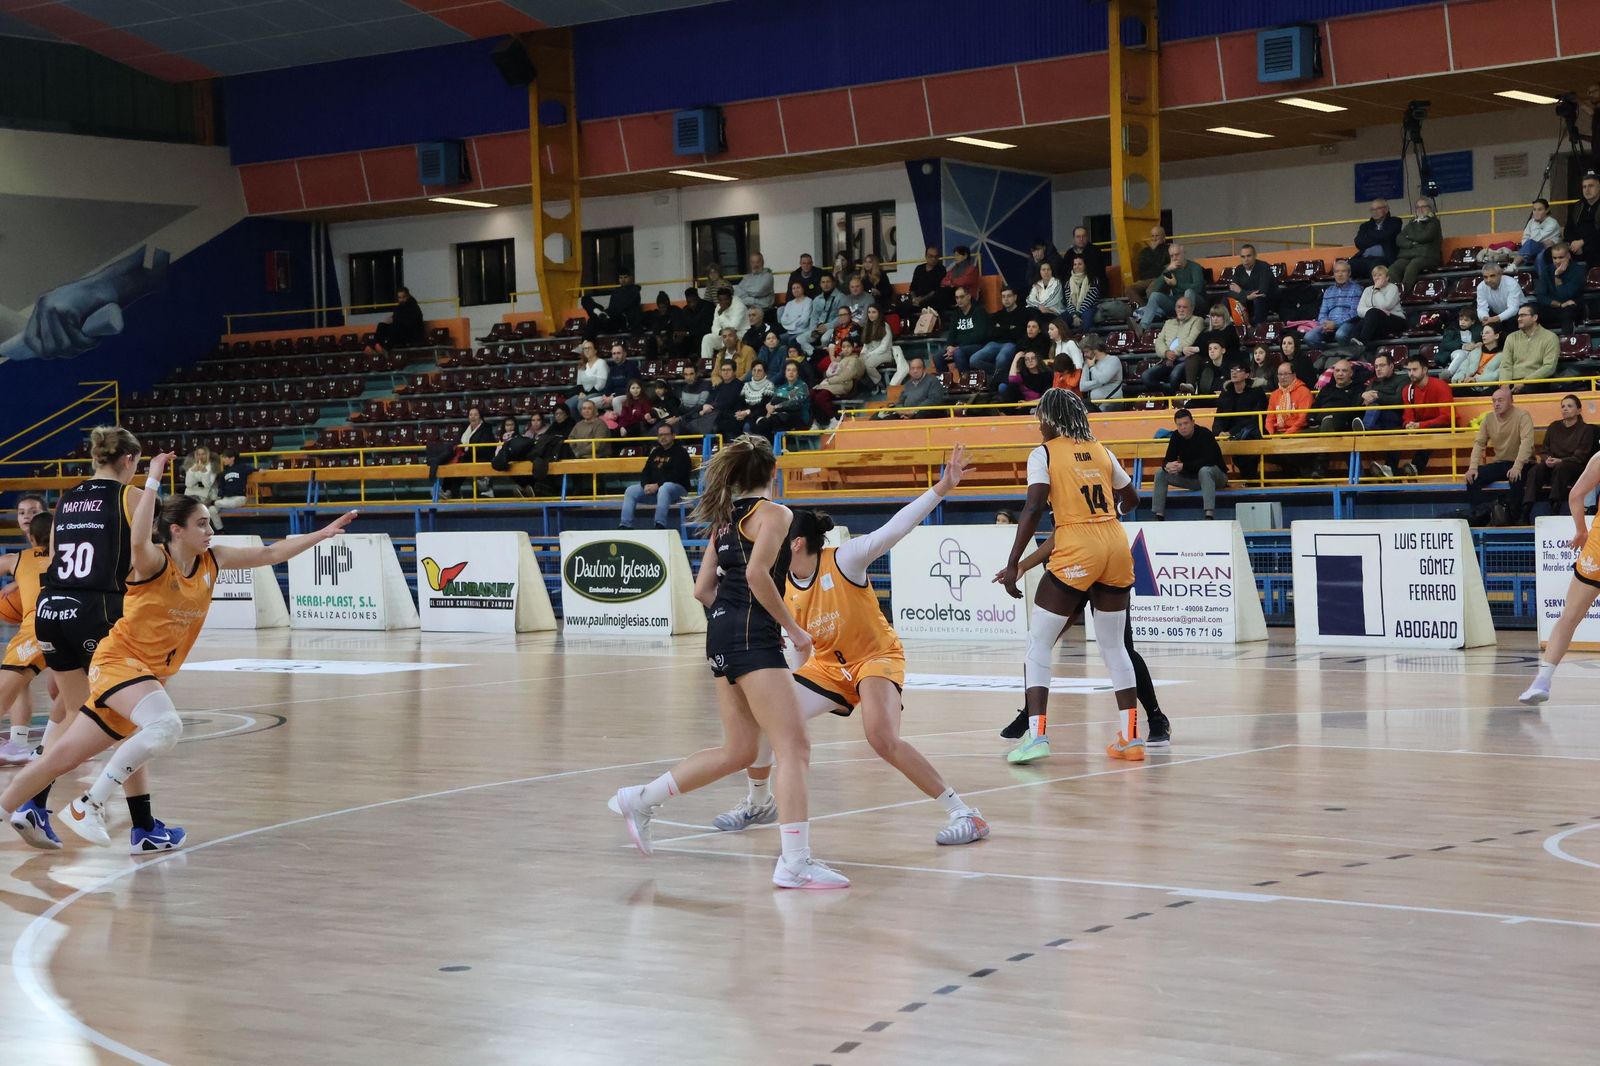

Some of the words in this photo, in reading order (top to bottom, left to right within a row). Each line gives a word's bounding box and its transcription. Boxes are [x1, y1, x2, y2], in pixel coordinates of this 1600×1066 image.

[1570, 337, 1577, 346] 9
[62, 499, 103, 513] MARTÍNEZ
[1080, 484, 1109, 514] 14
[1394, 532, 1417, 550] LUIS
[1420, 532, 1454, 550] FELIPE
[1542, 540, 1555, 548] E.S.
[57, 541, 95, 580] 30
[1560, 552, 1572, 560] 980
[574, 556, 616, 584] Paulino
[620, 556, 660, 584] Iglesias
[1420, 556, 1455, 575] GÓMEZ
[1542, 564, 1565, 572] Morales
[216, 568, 252, 584] ANIE
[1409, 584, 1456, 601] FERRERO
[358, 596, 377, 608] S.L.
[1130, 604, 1152, 612] Cruces
[1162, 604, 1175, 612] Entr
[1544, 599, 1566, 608] SERVI
[296, 609, 377, 620] SEÑALIZACIONES
[900, 602, 971, 622] recoletas
[976, 604, 1016, 622] salud
[1546, 610, 1561, 618] Gasól
[566, 614, 669, 629] www.paulinoiglesias.com
[1136, 627, 1146, 636] 85
[1148, 627, 1159, 636] 90
[1167, 628, 1184, 636] 605
[1186, 628, 1196, 636] 76
[1199, 628, 1208, 636] 71
[1211, 628, 1223, 637] 05
[1395, 620, 1458, 639] ABOGADO
[834, 650, 847, 664] 8
